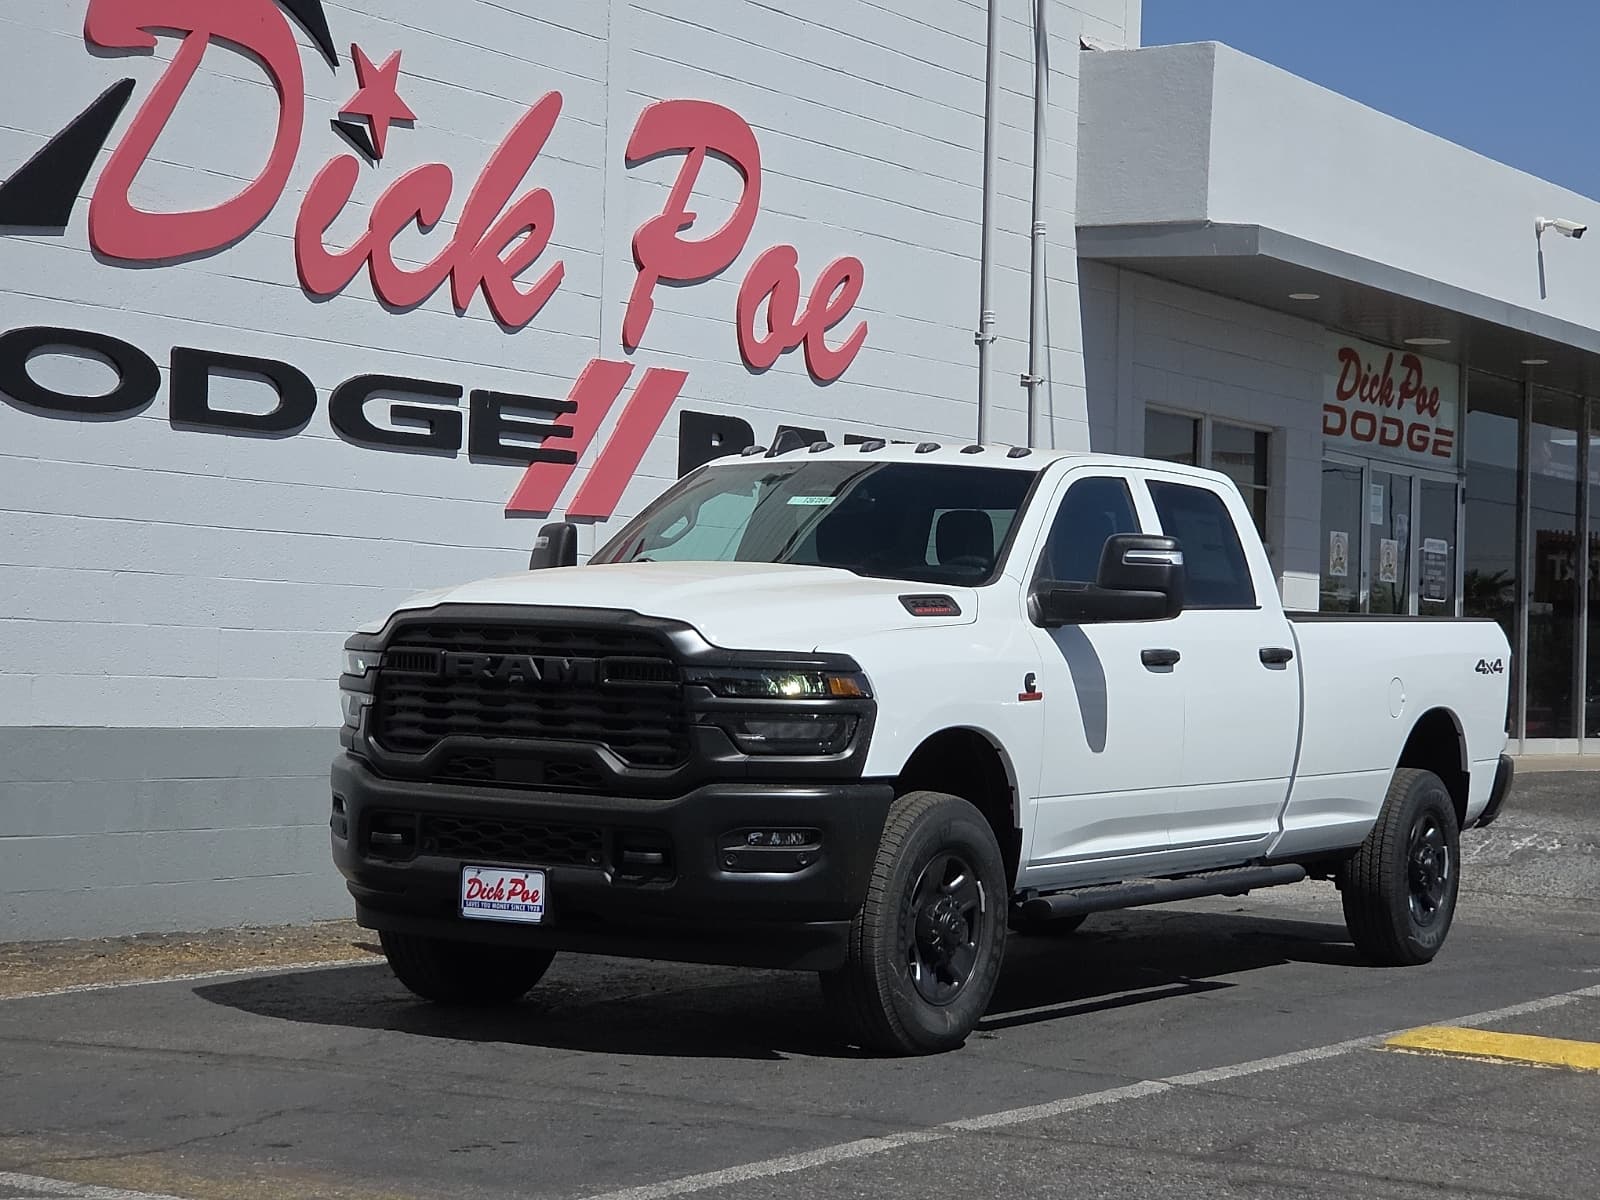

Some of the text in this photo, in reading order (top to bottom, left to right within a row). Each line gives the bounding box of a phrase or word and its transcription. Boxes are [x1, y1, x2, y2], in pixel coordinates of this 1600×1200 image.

[85, 0, 868, 382] Dick Poe
[1336, 347, 1440, 418] Dick Poe
[1322, 403, 1454, 458] DODGE
[444, 652, 600, 686] RAM
[1475, 658, 1504, 674] 4x4
[466, 877, 541, 903] Dick Poe
